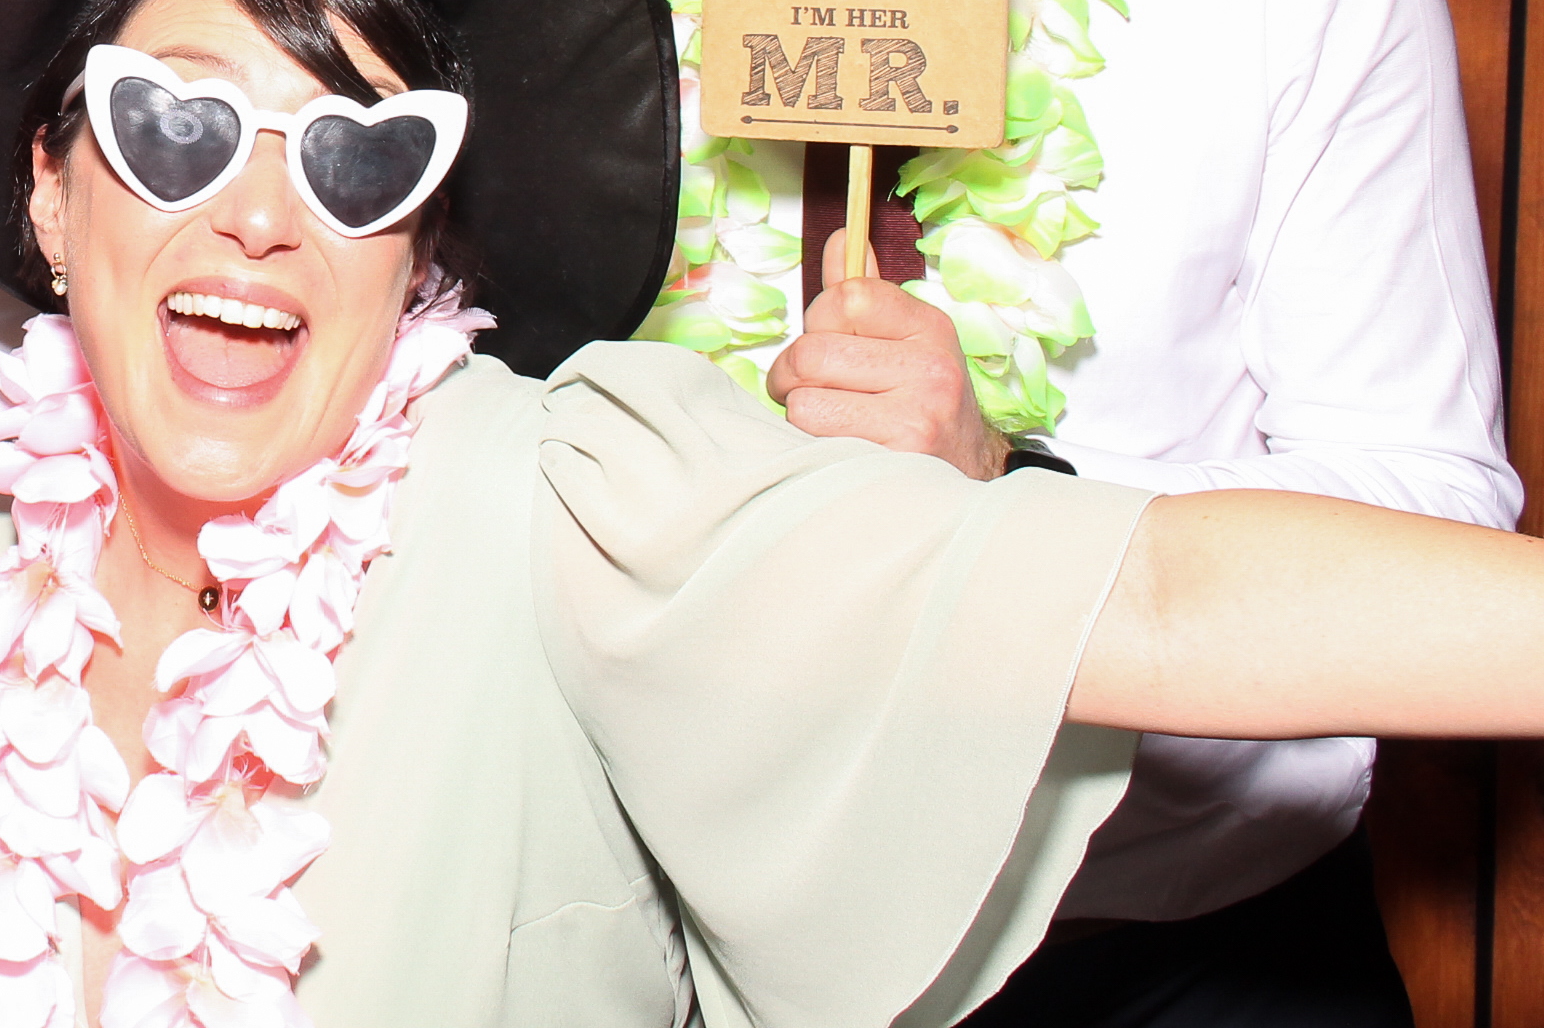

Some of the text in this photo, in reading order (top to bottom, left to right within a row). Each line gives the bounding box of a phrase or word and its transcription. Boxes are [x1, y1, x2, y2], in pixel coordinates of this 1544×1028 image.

[791, 7, 909, 29] I'M HER
[741, 34, 958, 115] MR.
